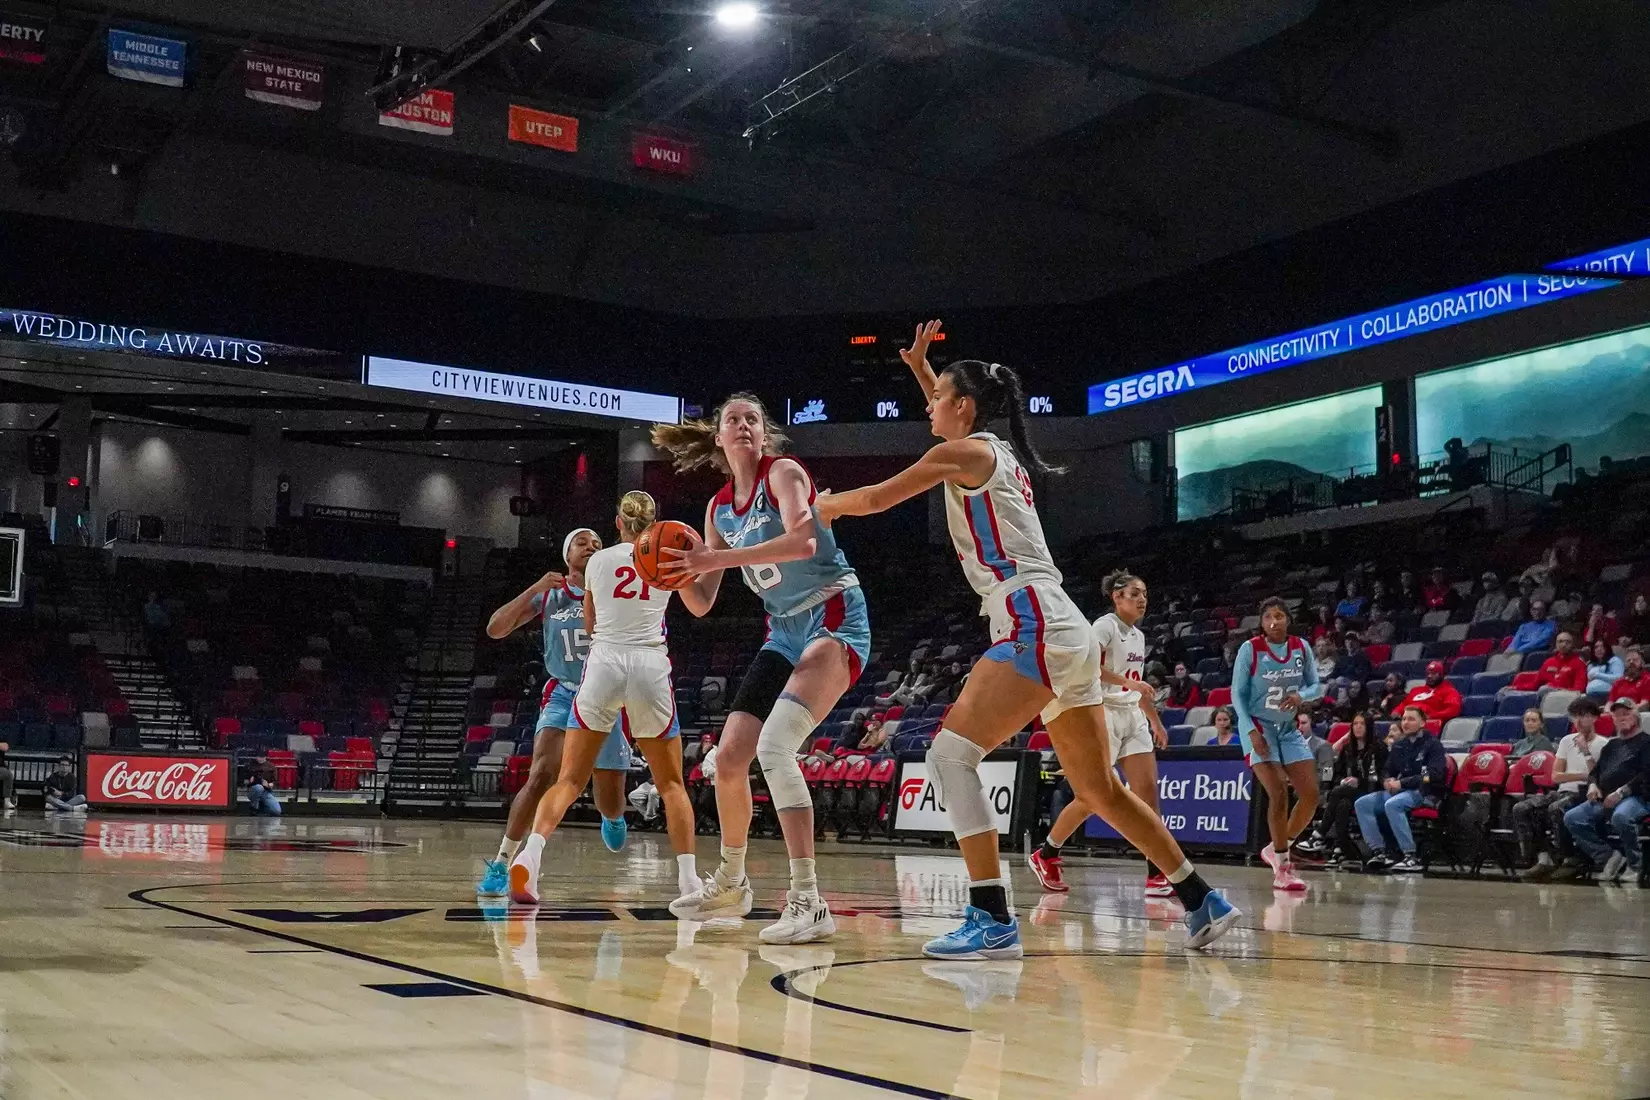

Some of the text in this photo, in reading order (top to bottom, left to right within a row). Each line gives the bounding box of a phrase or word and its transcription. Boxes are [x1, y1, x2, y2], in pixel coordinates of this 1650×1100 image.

[0, 23, 44, 42] ERTY
[125, 40, 168, 56] MIDDLE
[113, 51, 179, 70] TENNESSEE
[246, 60, 320, 83] NEW MEXICO
[265, 77, 302, 92] STATE
[526, 121, 562, 137] UTEP
[650, 147, 680, 164] WKU
[1227, 328, 1341, 375] CONNECTIVITY
[1361, 283, 1512, 339] COLLABORATION
[12, 313, 148, 349] WEDDING
[157, 332, 269, 365] AWAITS.
[432, 370, 621, 411] CITYVIEWVENUES.COM
[1103, 366, 1196, 408] SEGRA
[877, 401, 899, 418] 0%
[1029, 396, 1053, 414] 0%
[280, 482, 290, 492] 9
[560, 628, 590, 662] 15
[101, 761, 217, 800] Coca-Cola
[1194, 771, 1251, 800] Bank
[1196, 816, 1229, 831] FULL
